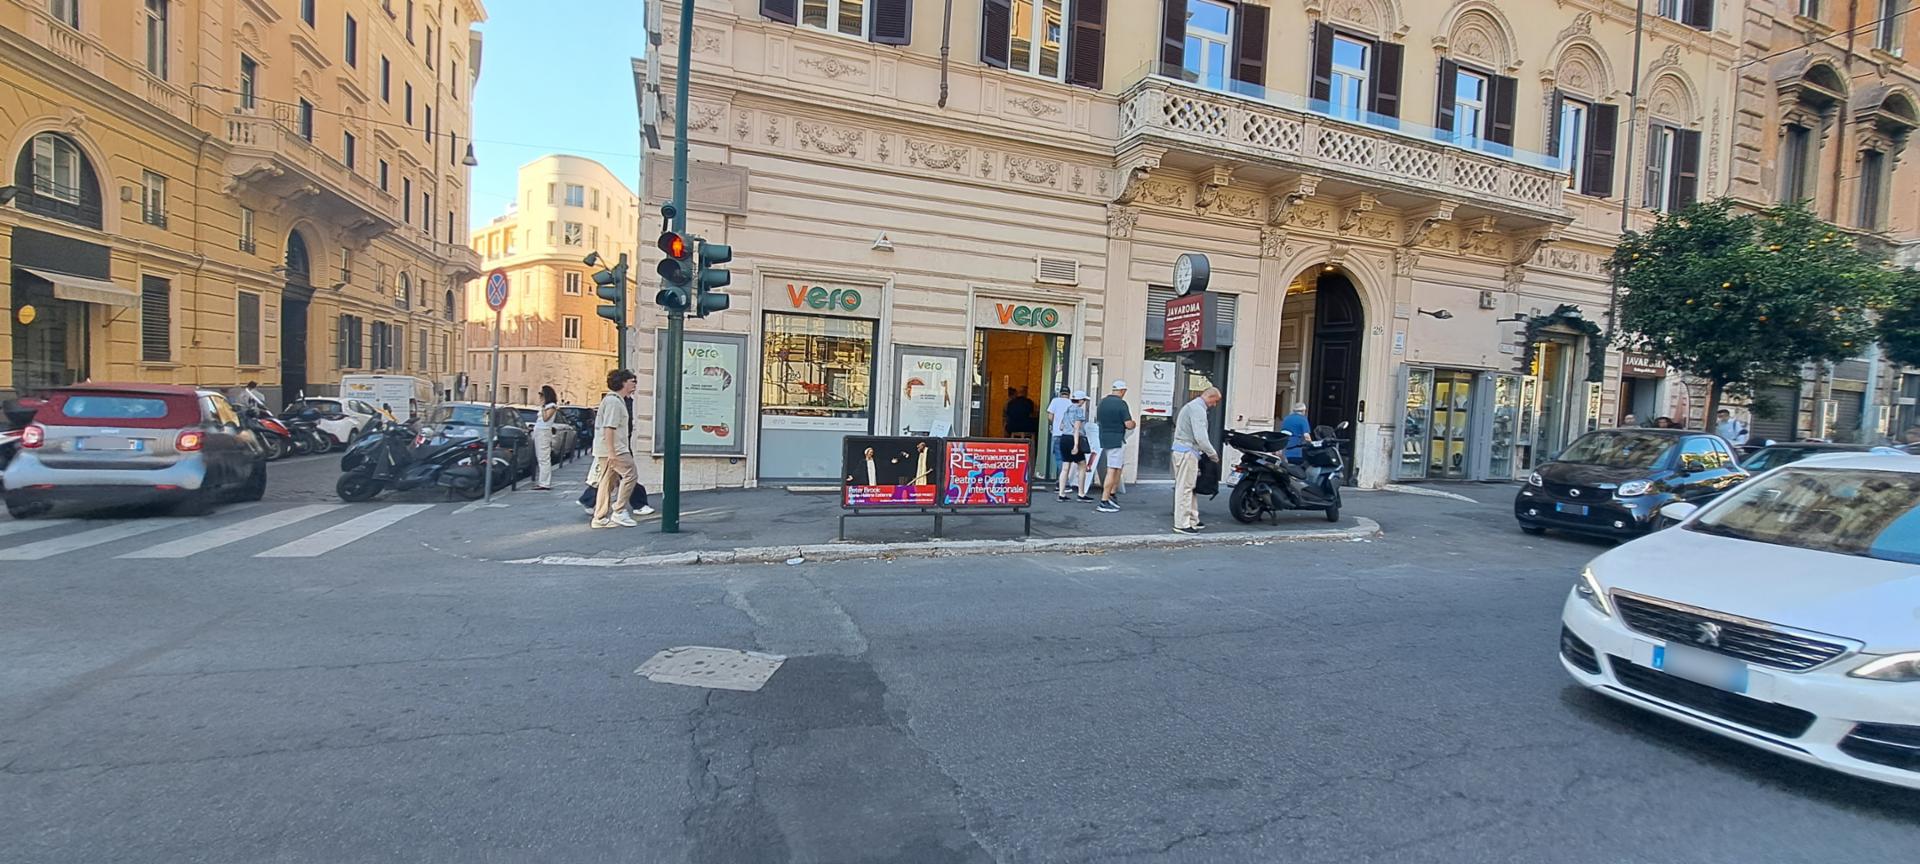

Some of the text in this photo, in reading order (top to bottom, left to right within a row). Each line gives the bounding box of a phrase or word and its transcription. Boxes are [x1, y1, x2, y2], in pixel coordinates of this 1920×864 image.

[786, 283, 862, 312] vero
[1167, 302, 1201, 317] JAVAROMA
[995, 303, 1059, 328] vero
[687, 347, 720, 358] vero
[917, 361, 943, 371] vero
[973, 453, 1015, 463] Romaeuropa
[950, 475, 976, 484] Teatro
[984, 475, 1010, 484] Danza
